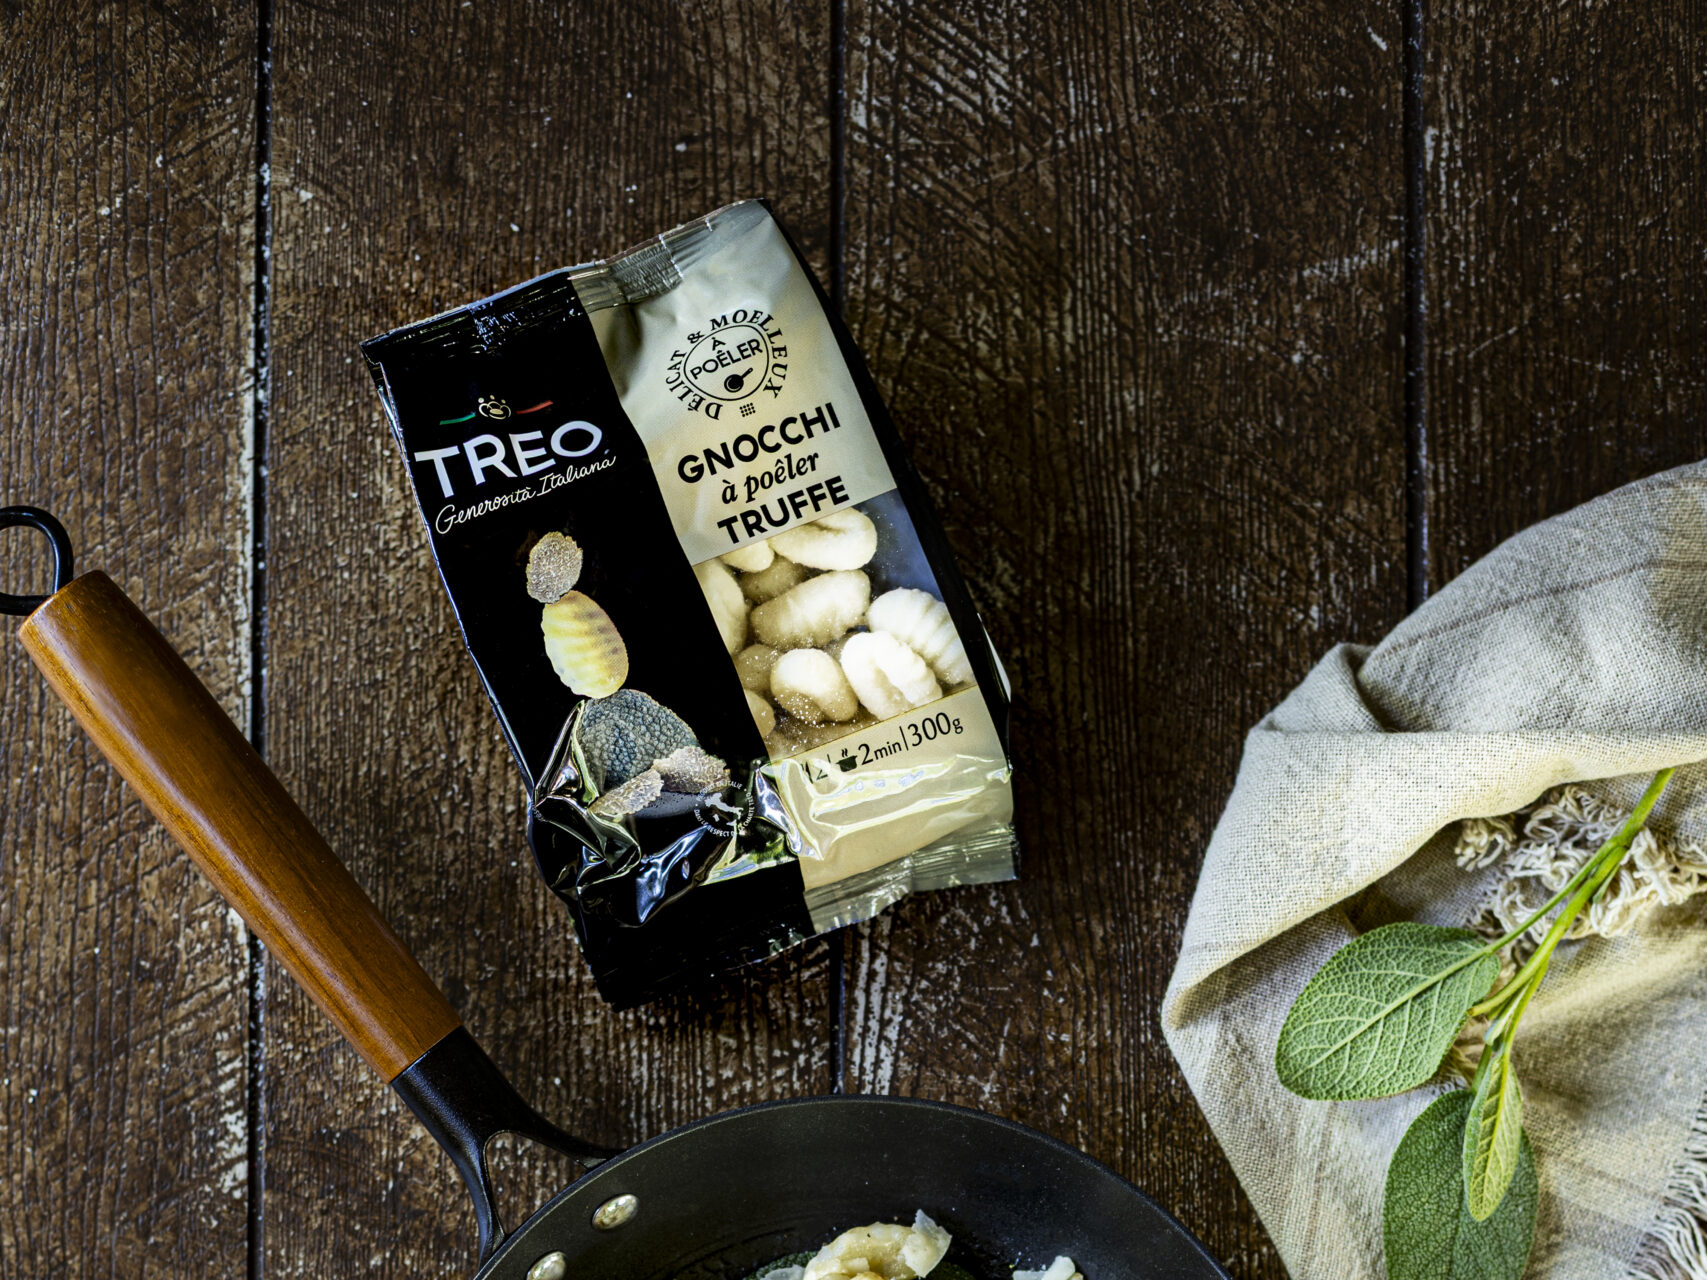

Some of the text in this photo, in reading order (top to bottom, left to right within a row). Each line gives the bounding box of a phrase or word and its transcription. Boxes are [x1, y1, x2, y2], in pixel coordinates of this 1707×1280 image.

[666, 309, 788, 420] DÉLICAT & MOELLEUX
[690, 338, 763, 380] POÊLER
[711, 337, 726, 350] À
[414, 420, 602, 498] TREO
[677, 402, 841, 483] GNOCCHI
[435, 456, 617, 534] Generosità Italiana
[716, 475, 850, 544] TRUFFE
[721, 452, 819, 504] à poêler
[907, 712, 963, 747] 300g
